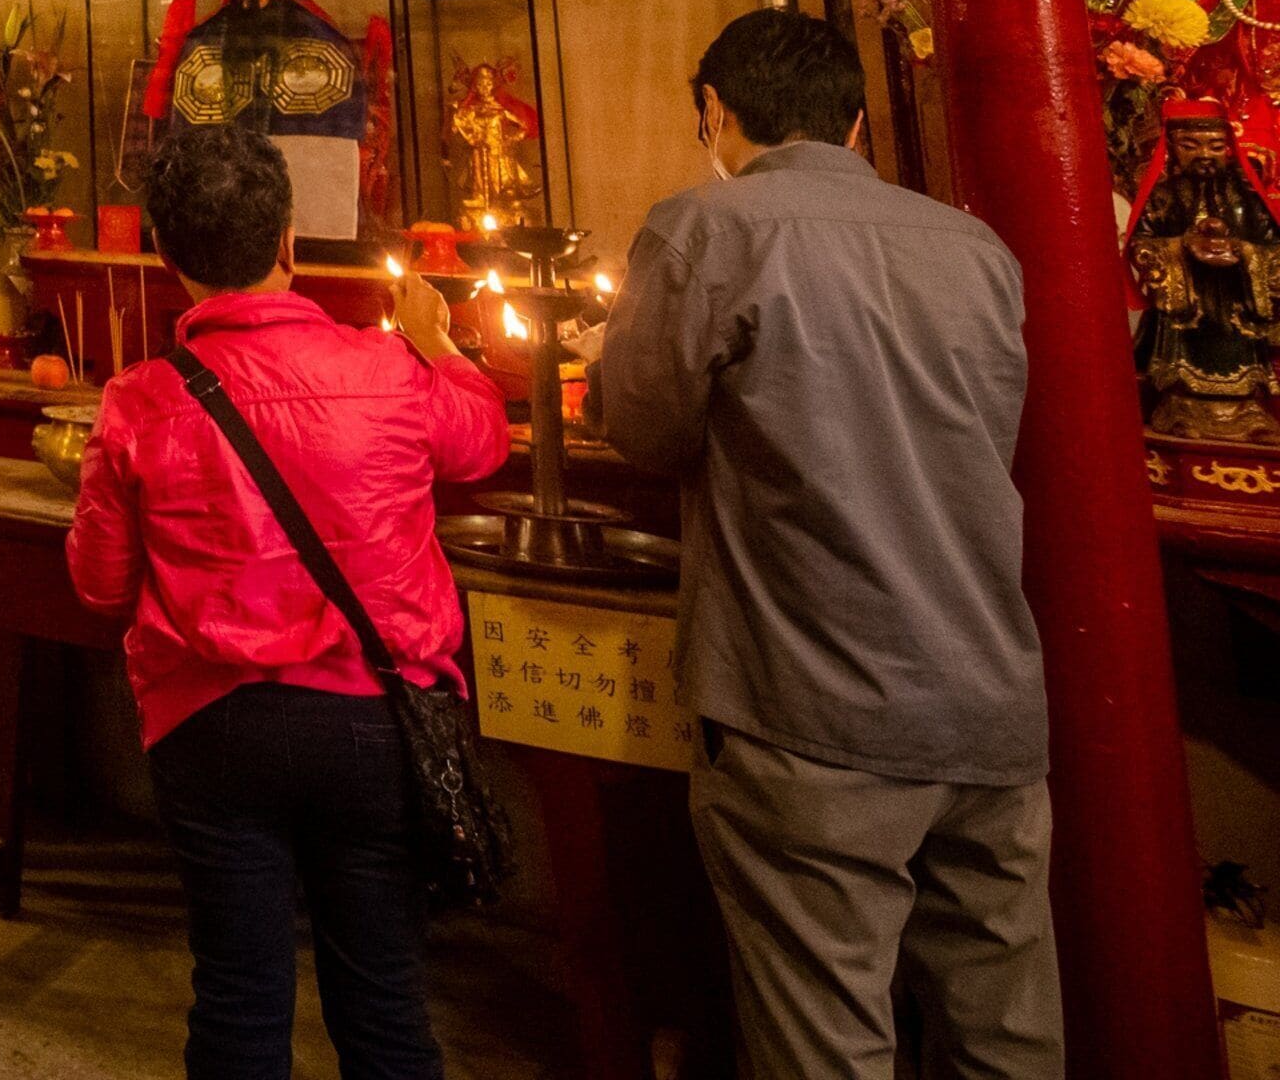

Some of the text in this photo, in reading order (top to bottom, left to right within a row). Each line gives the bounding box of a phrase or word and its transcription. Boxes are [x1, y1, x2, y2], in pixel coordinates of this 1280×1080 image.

[483, 620, 675, 669] 因安全考
[487, 654, 682, 706] 善信切勿擅
